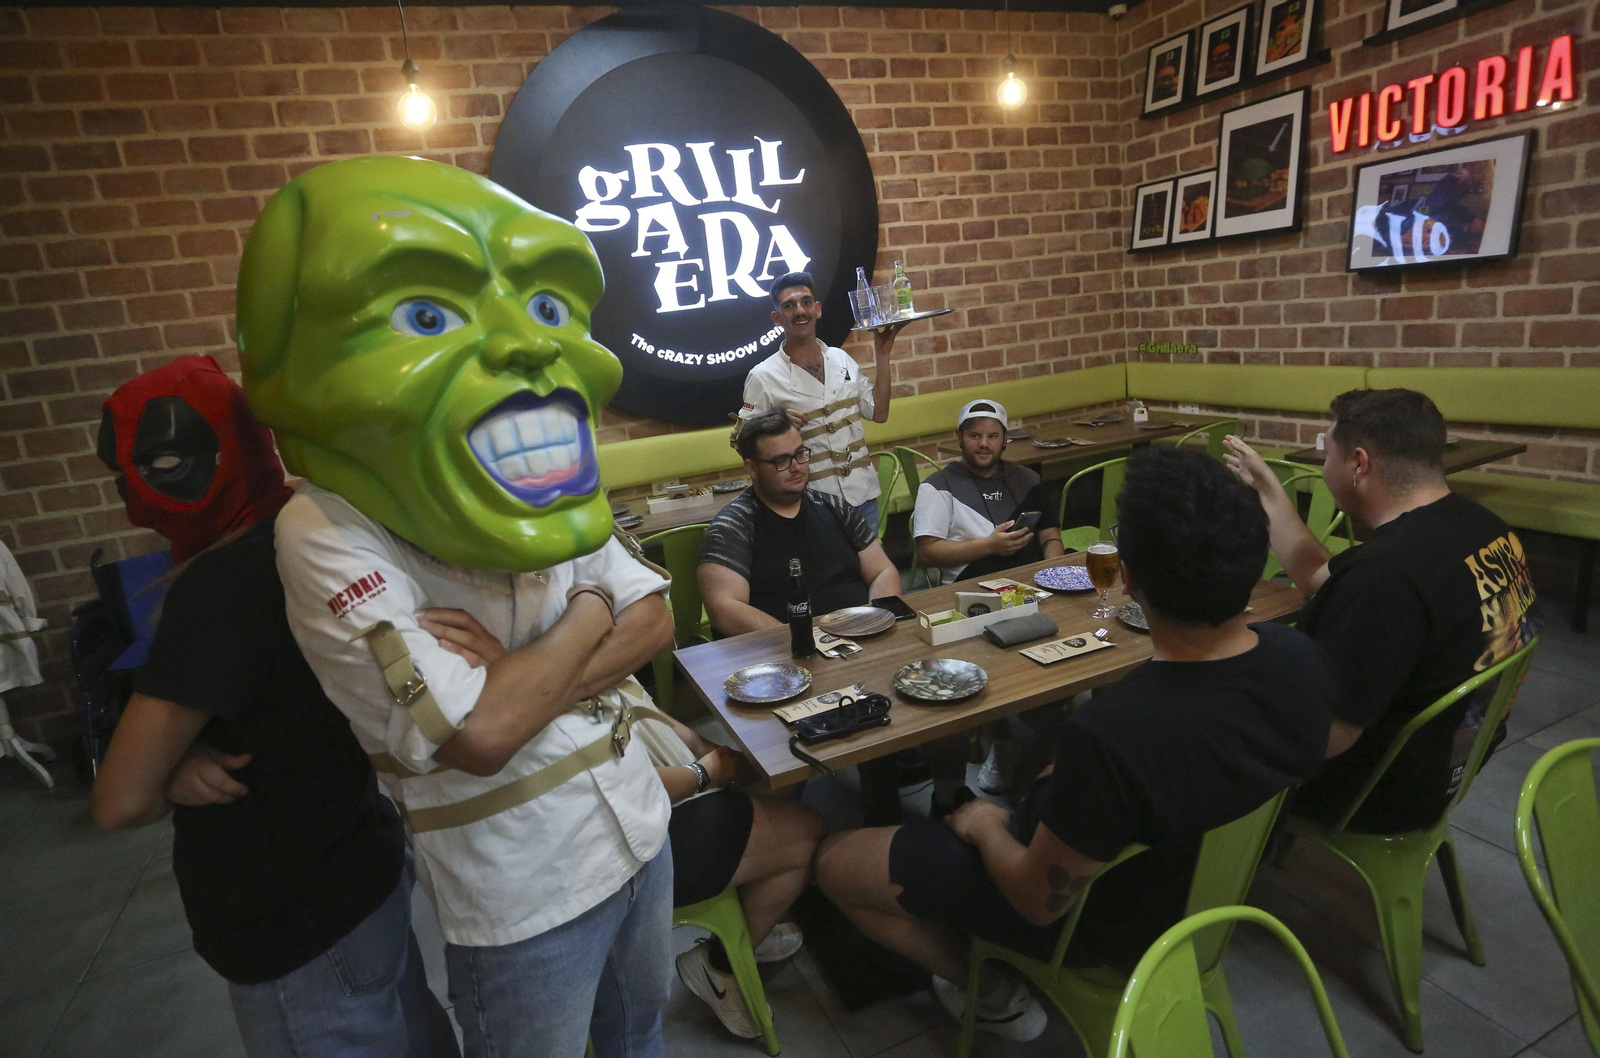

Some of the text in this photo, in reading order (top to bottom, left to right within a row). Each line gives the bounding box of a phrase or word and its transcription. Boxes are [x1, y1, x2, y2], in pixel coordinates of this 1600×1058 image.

[1329, 34, 1574, 153] VICTORIA
[631, 332, 655, 354] The
[656, 349, 704, 366] cRAZY
[706, 340, 758, 366] SHOOW
[326, 570, 387, 616] VICTORIA
